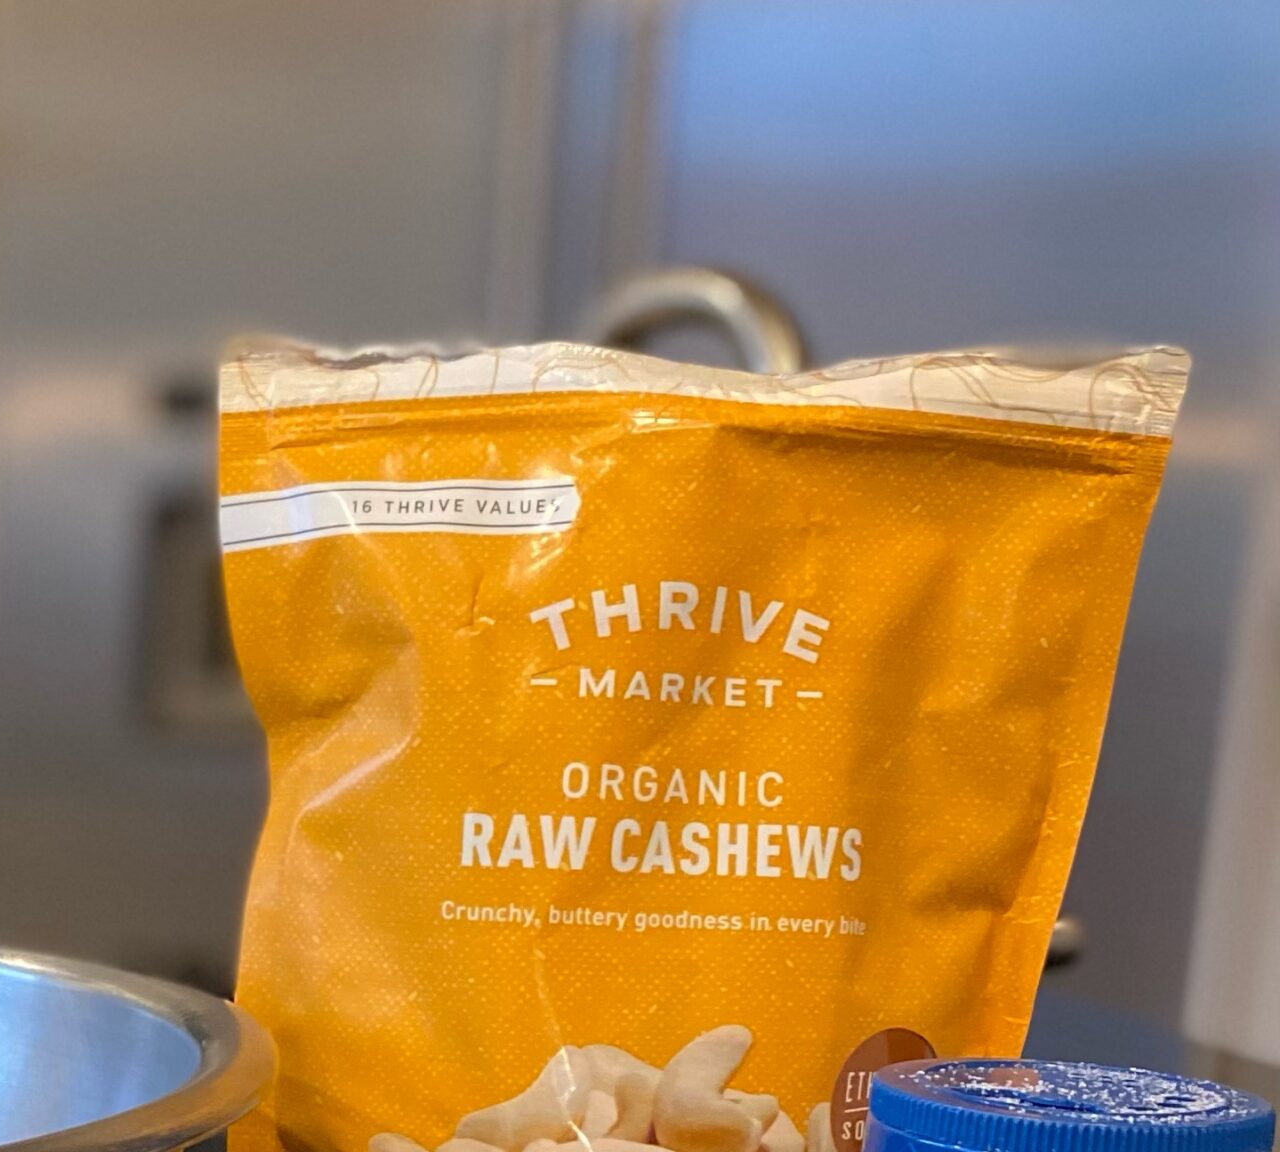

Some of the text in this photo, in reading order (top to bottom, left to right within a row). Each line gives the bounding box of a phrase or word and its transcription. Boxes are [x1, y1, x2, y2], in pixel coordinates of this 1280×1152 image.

[353, 500, 373, 513] 16
[385, 498, 465, 514] THRIVE
[529, 580, 831, 665] THRIVE
[578, 667, 783, 709] MARKET
[561, 761, 785, 808] ORGANIC
[460, 812, 863, 882] RAW CASHEWS
[441, 900, 867, 938] Crunchy, buttery goodness in every bite
[841, 1119, 865, 1141] SO
